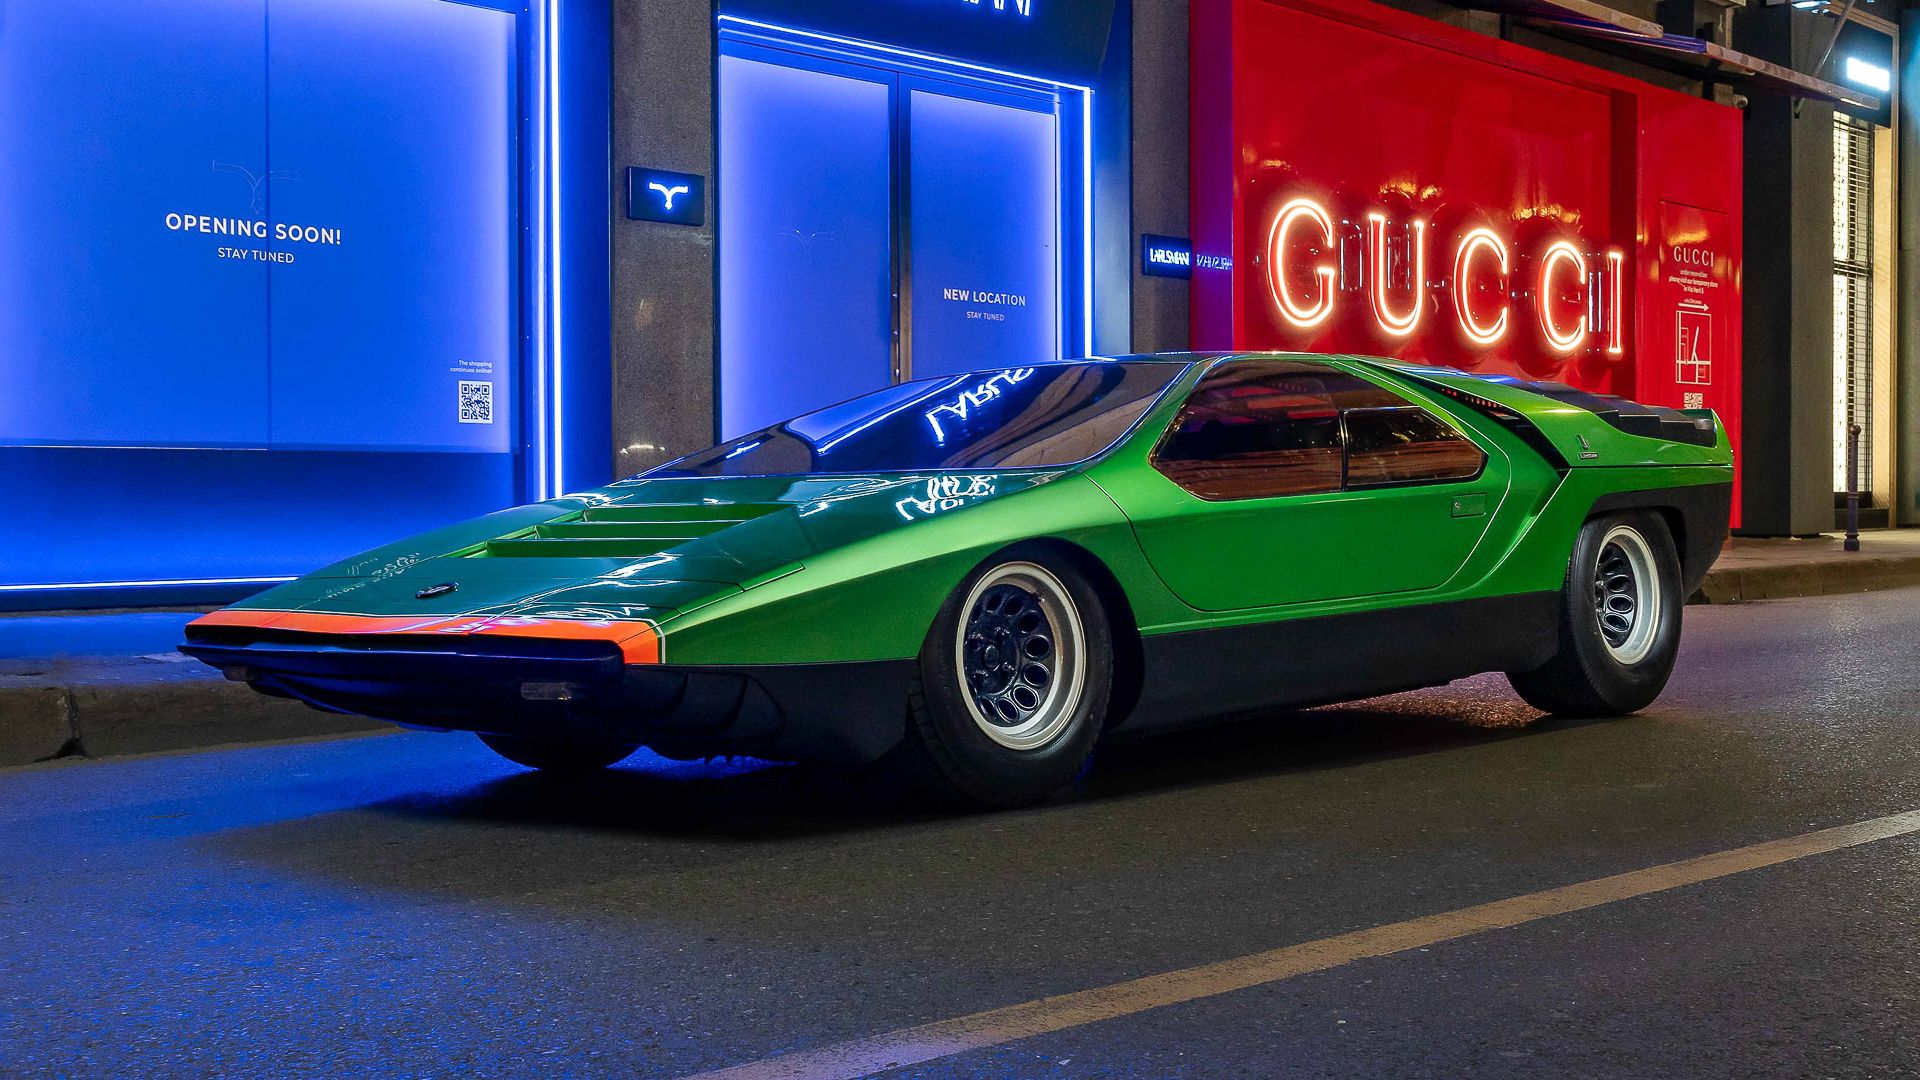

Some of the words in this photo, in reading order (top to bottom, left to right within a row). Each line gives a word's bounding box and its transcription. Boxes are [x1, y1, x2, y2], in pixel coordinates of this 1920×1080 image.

[165, 212, 268, 239] OPENING
[275, 223, 342, 245] SOON!
[217, 247, 248, 260] STAY
[251, 249, 295, 264] TUNED
[1673, 245, 1714, 268] GUCCI
[1266, 198, 1623, 354] GUCCI
[943, 288, 970, 302] NEW
[973, 291, 1026, 307] LOCATION
[966, 311, 982, 319] STAY
[983, 312, 1005, 321] TUNED
